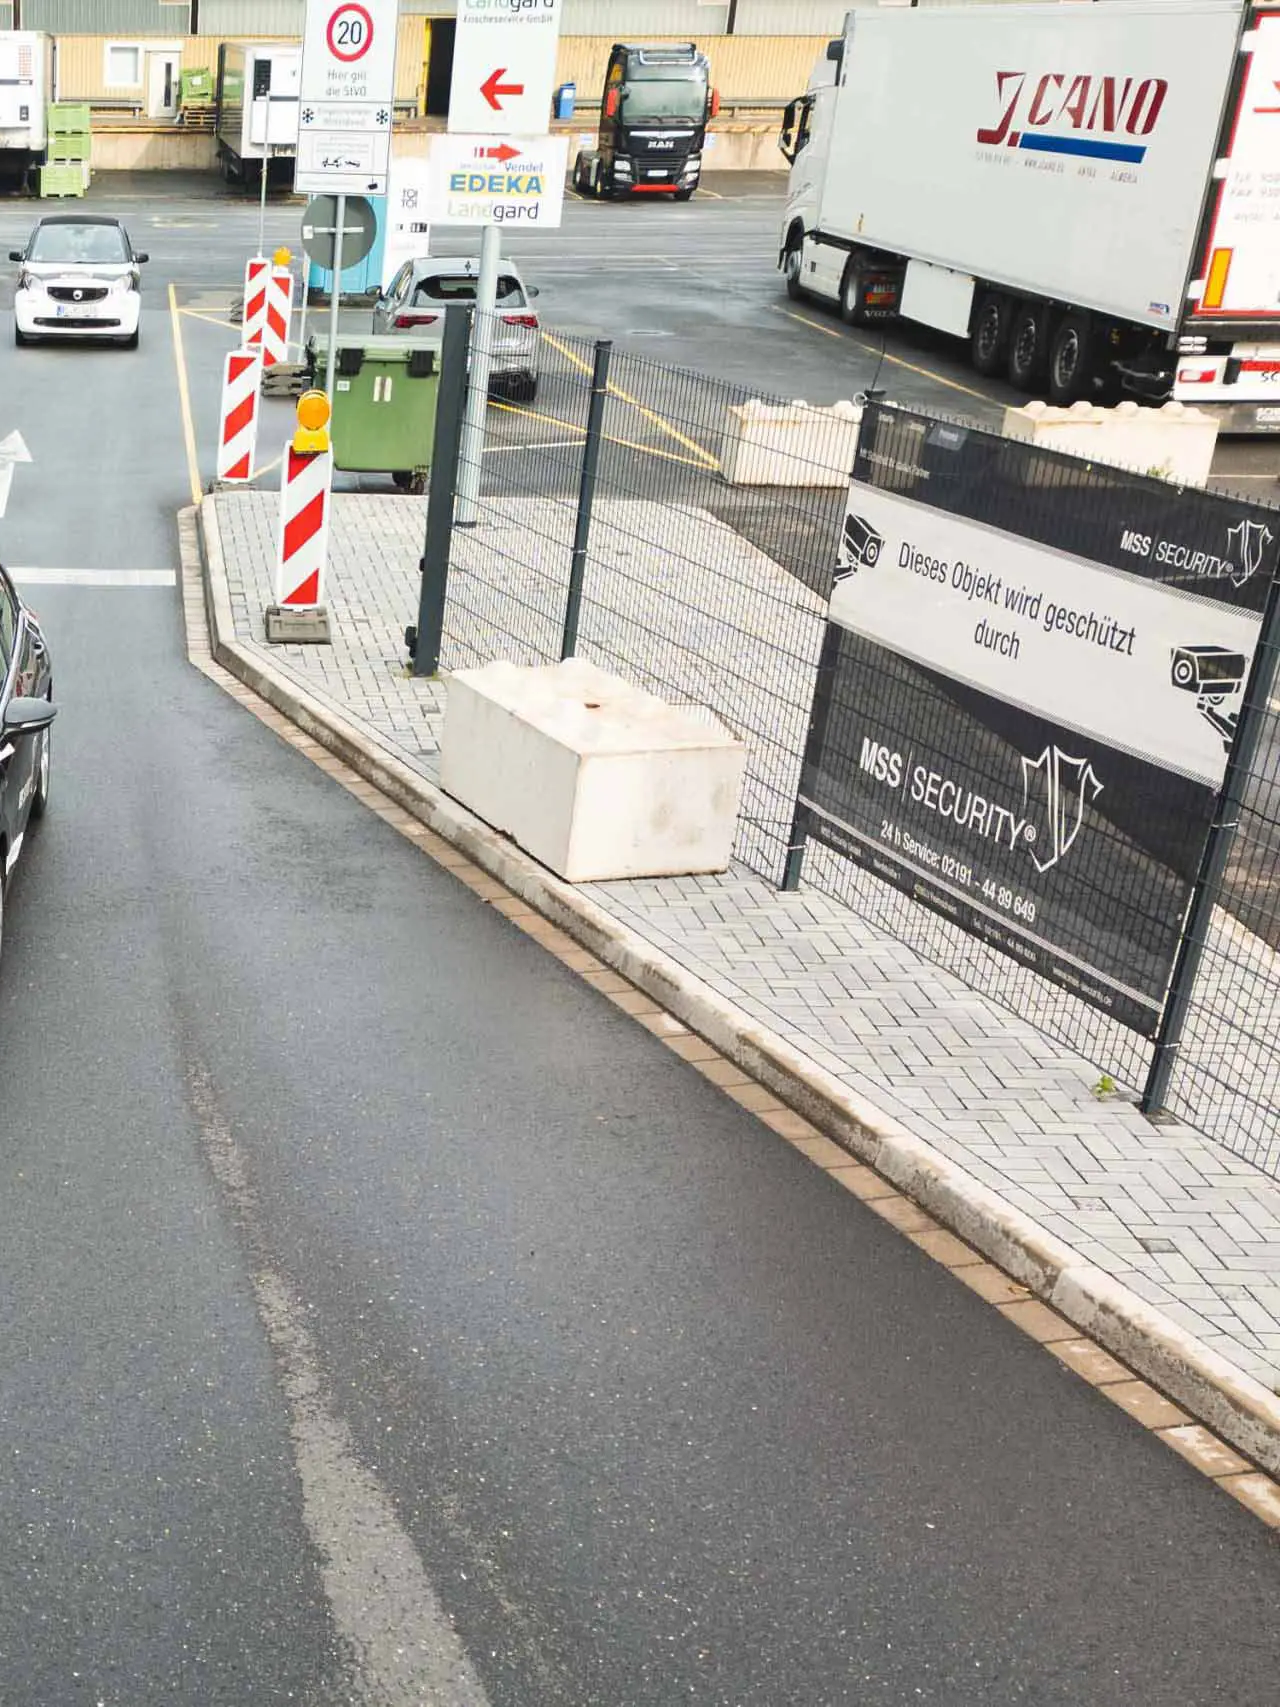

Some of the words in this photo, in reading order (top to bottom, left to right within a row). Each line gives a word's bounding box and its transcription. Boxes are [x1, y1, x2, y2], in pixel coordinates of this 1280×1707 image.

[337, 20, 363, 45] 20
[647, 140, 675, 149] MAN
[449, 173, 543, 194] EDEKA
[447, 200, 540, 223] Landgard
[1120, 530, 1153, 556] MSS
[898, 541, 948, 584] Dieses
[951, 561, 1002, 605] Objekt
[1004, 585, 1044, 620] wird
[1043, 601, 1137, 656] geschützt
[973, 618, 1021, 660] durch
[859, 736, 903, 788] MSS
[880, 819, 893, 841] 24
[894, 826, 901, 847] h
[902, 831, 940, 868] Service:
[941, 855, 972, 887] 02191
[981, 878, 997, 901] 44
[997, 885, 1013, 910] 89
[1013, 896, 1036, 923] 649
